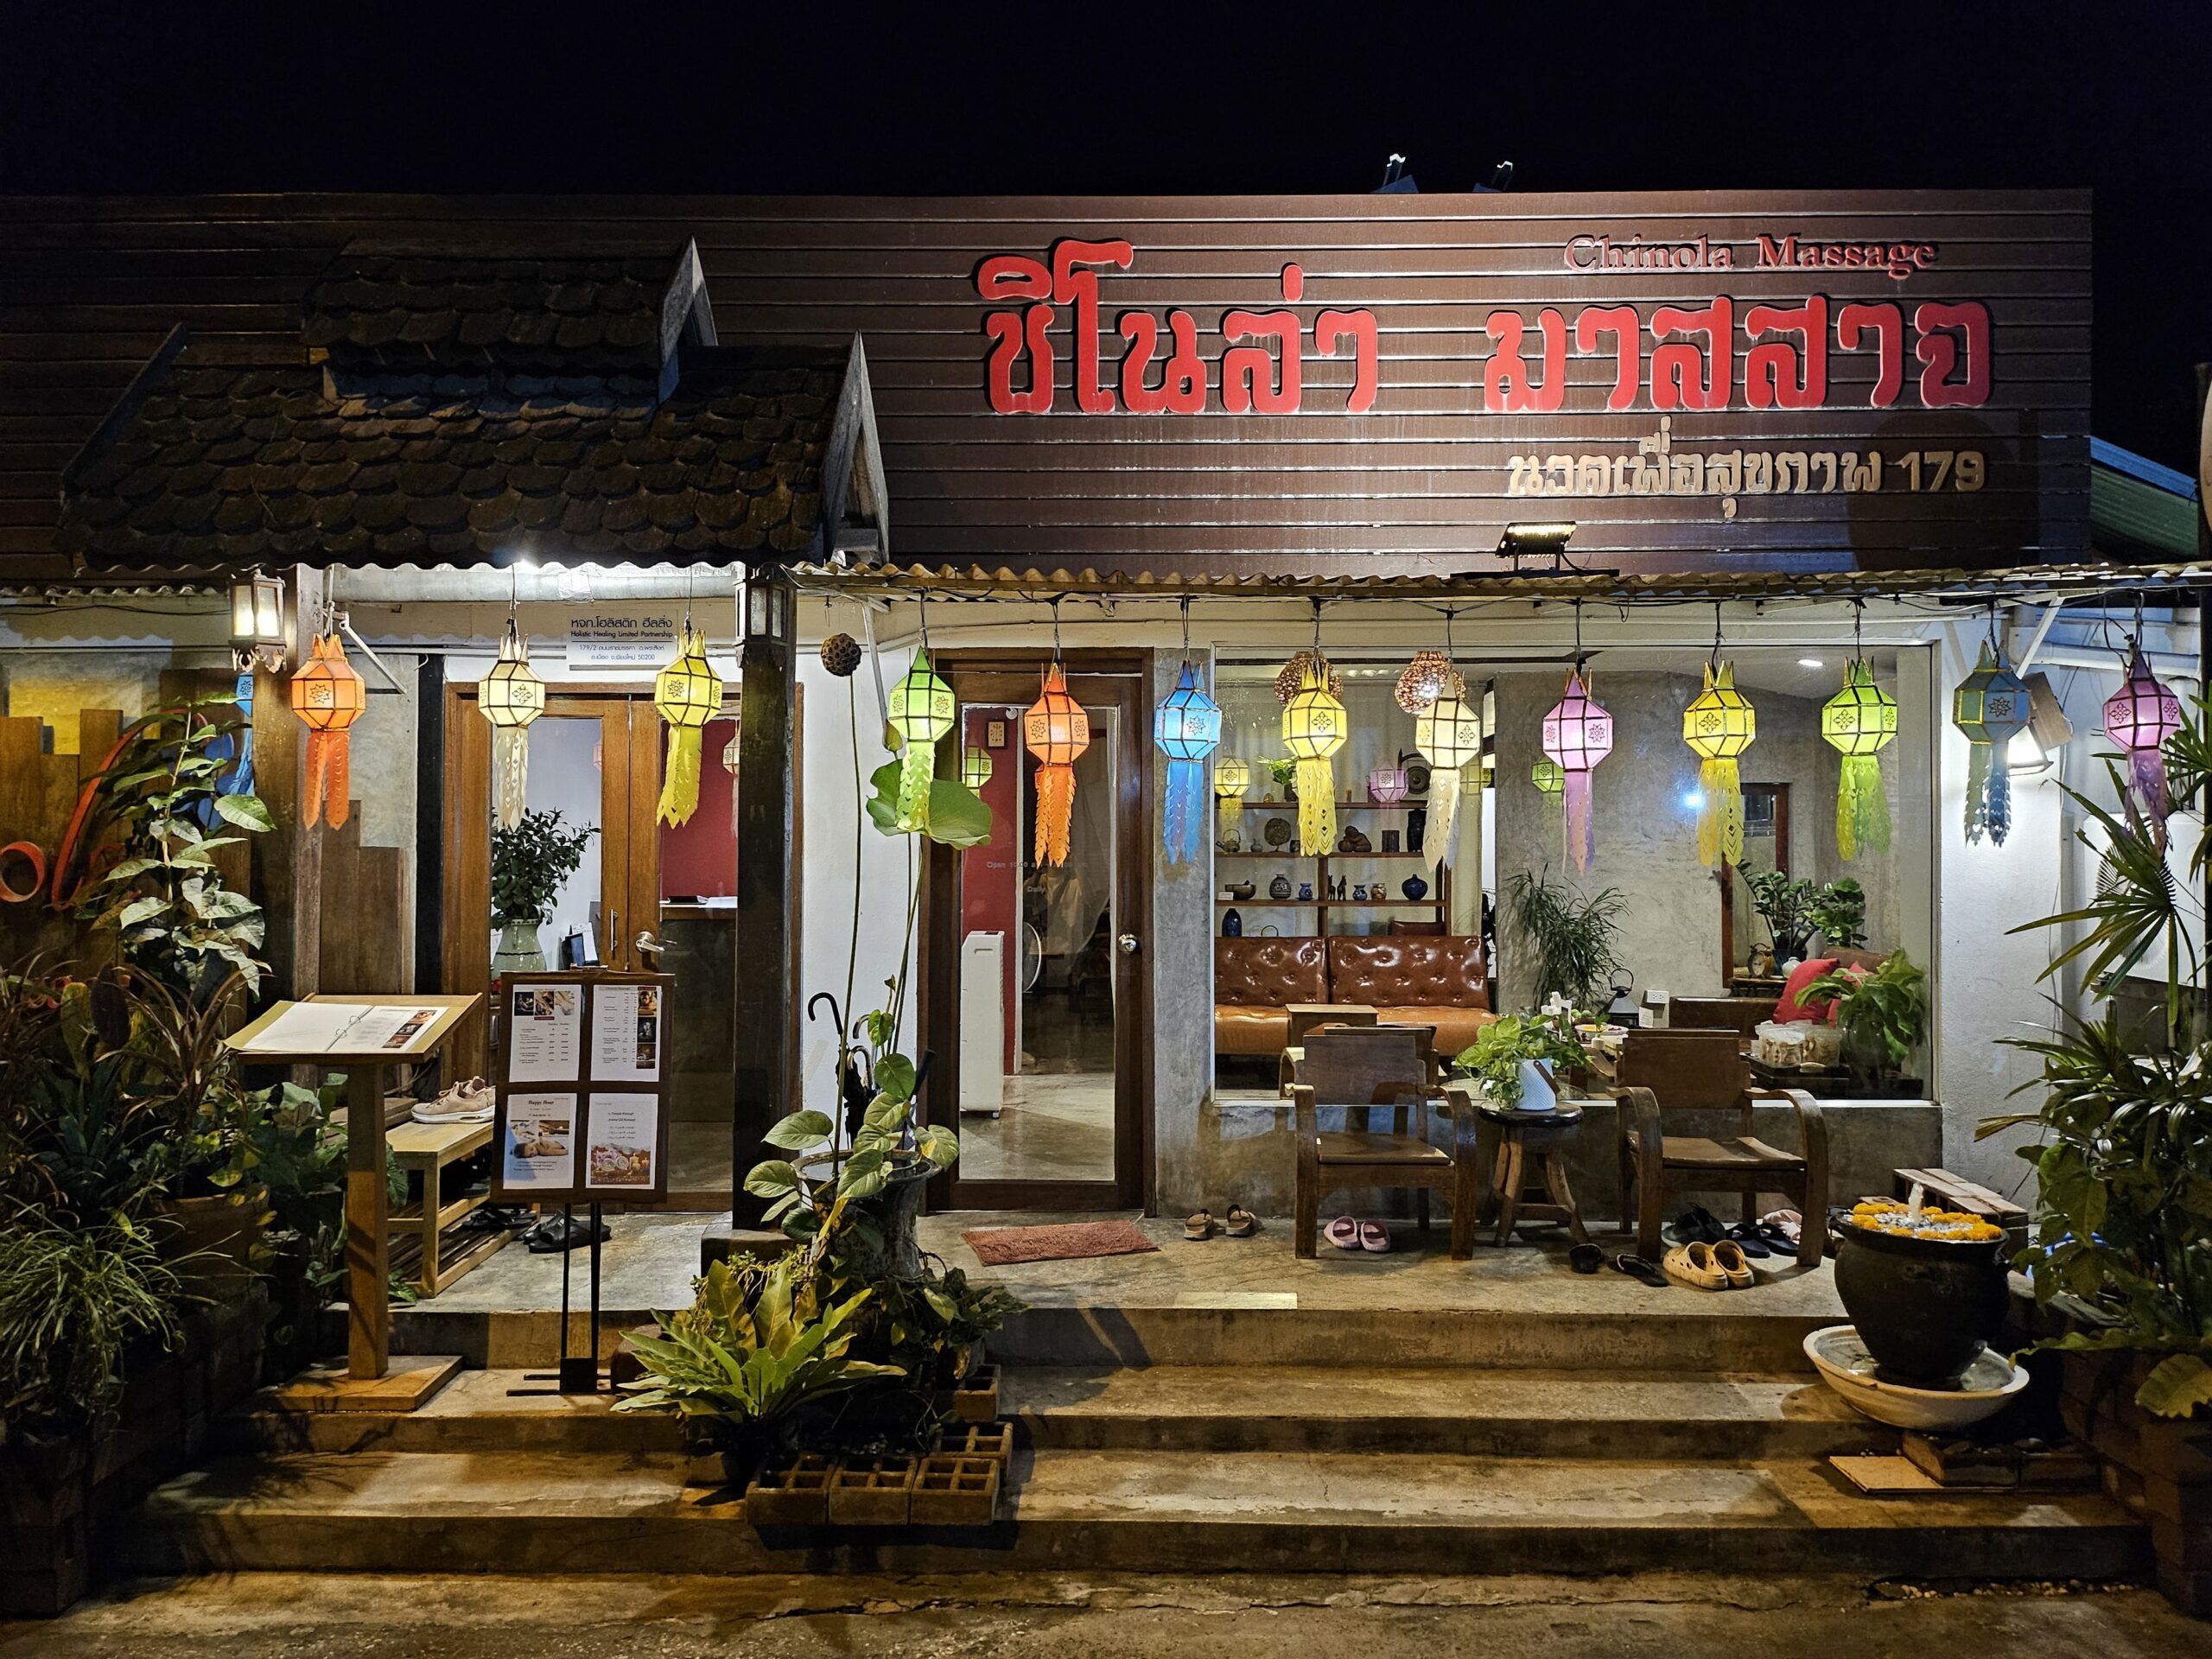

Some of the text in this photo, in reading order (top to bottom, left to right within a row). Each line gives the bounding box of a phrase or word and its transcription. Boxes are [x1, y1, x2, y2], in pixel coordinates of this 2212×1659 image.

[1565, 234, 1939, 280] Chinola Massage
[976, 239, 1378, 414] ชิโนล่า
[1509, 416, 1986, 518] นวดเพื่อสุขภาพ 179
[594, 631, 616, 639] Healing
[640, 631, 673, 639] Partnership
